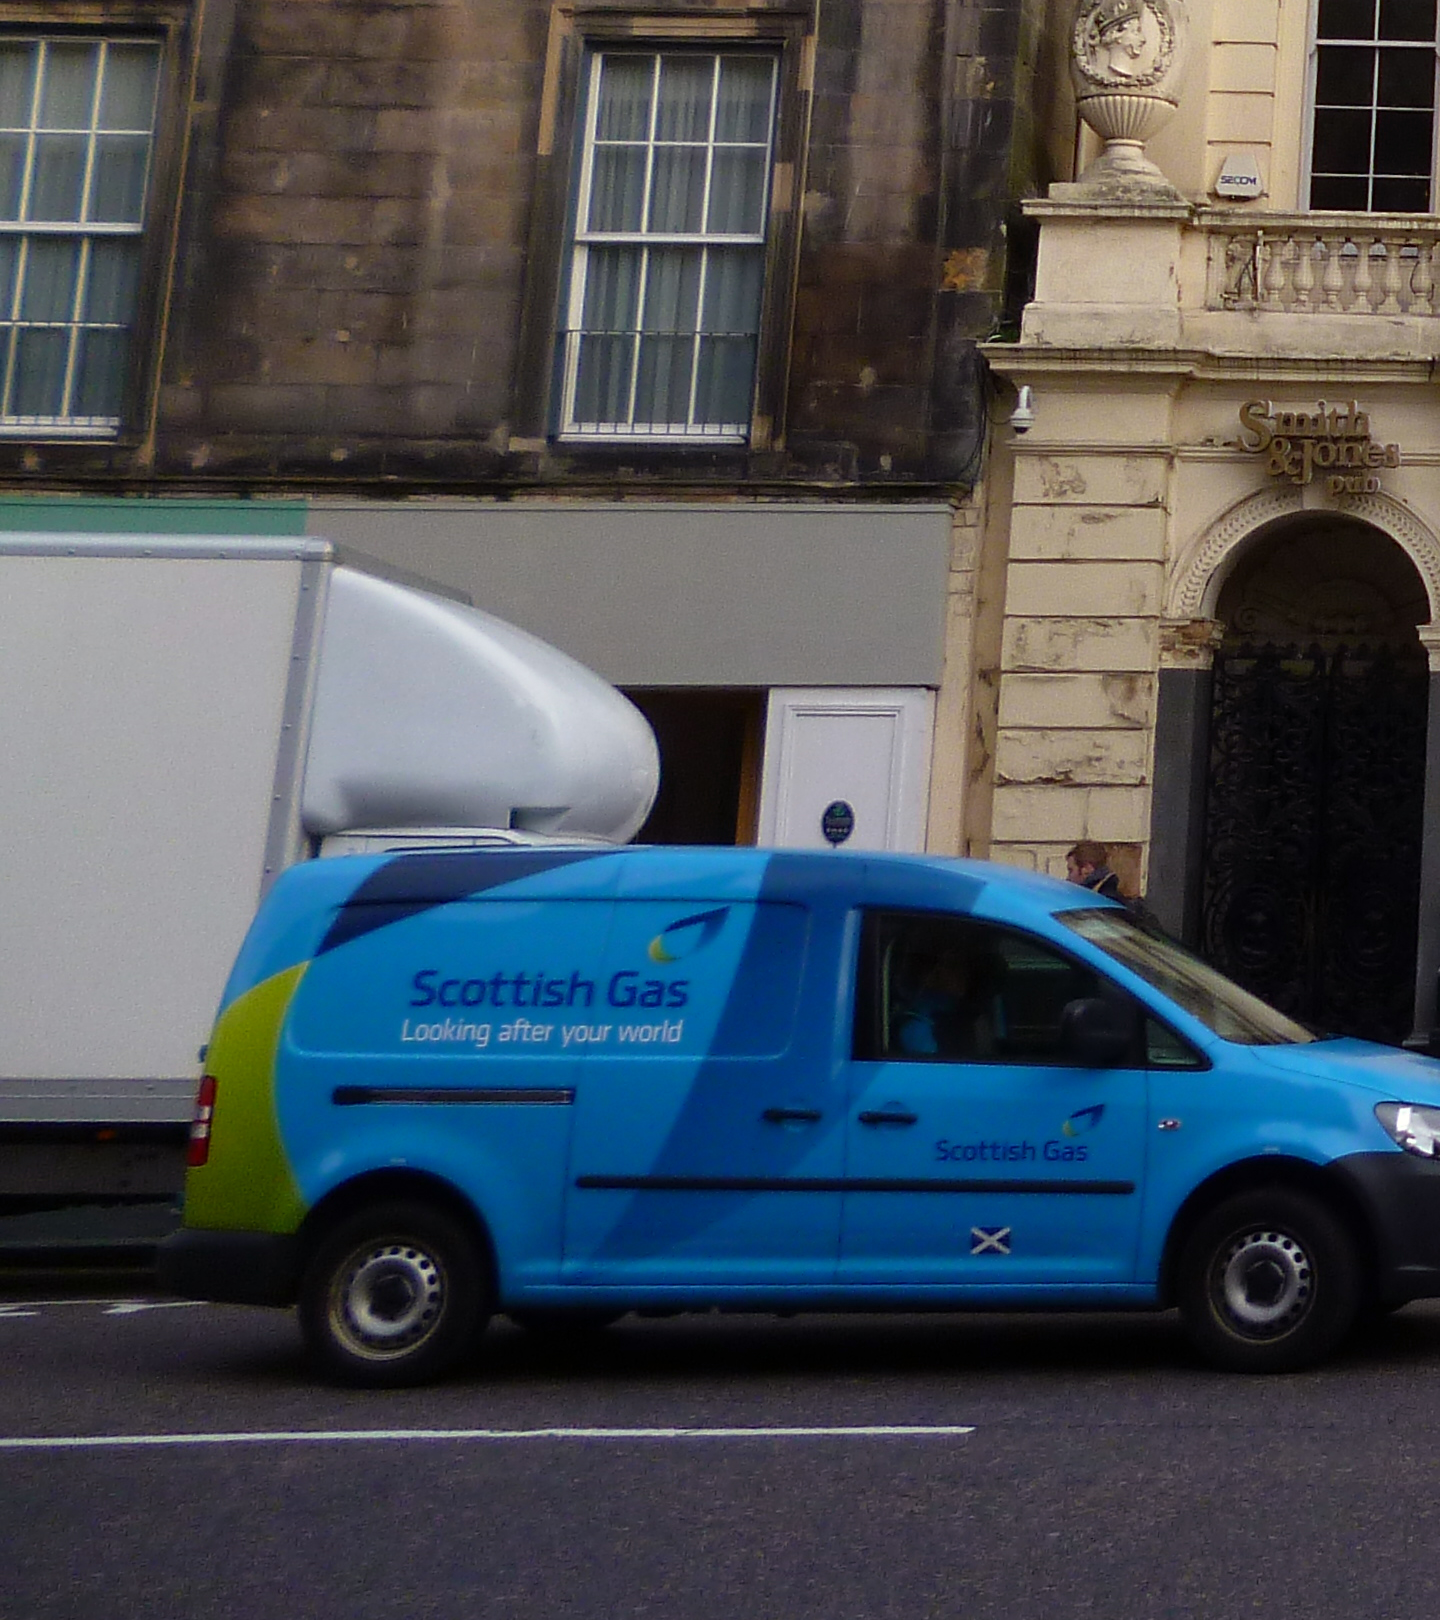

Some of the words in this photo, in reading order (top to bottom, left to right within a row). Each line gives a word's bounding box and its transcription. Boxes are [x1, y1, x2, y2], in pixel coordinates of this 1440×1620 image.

[1220, 174, 1257, 186] SECOM
[1238, 399, 1372, 454] Smith
[1328, 470, 1382, 498] pub
[408, 969, 595, 1008] Scottish
[606, 970, 690, 1008] Gas
[400, 1018, 491, 1048] Looking
[498, 1017, 554, 1042] after
[561, 1024, 613, 1048] your
[617, 1019, 684, 1042] world
[934, 1139, 1037, 1162] Scottish
[1043, 1140, 1089, 1162] Gas
